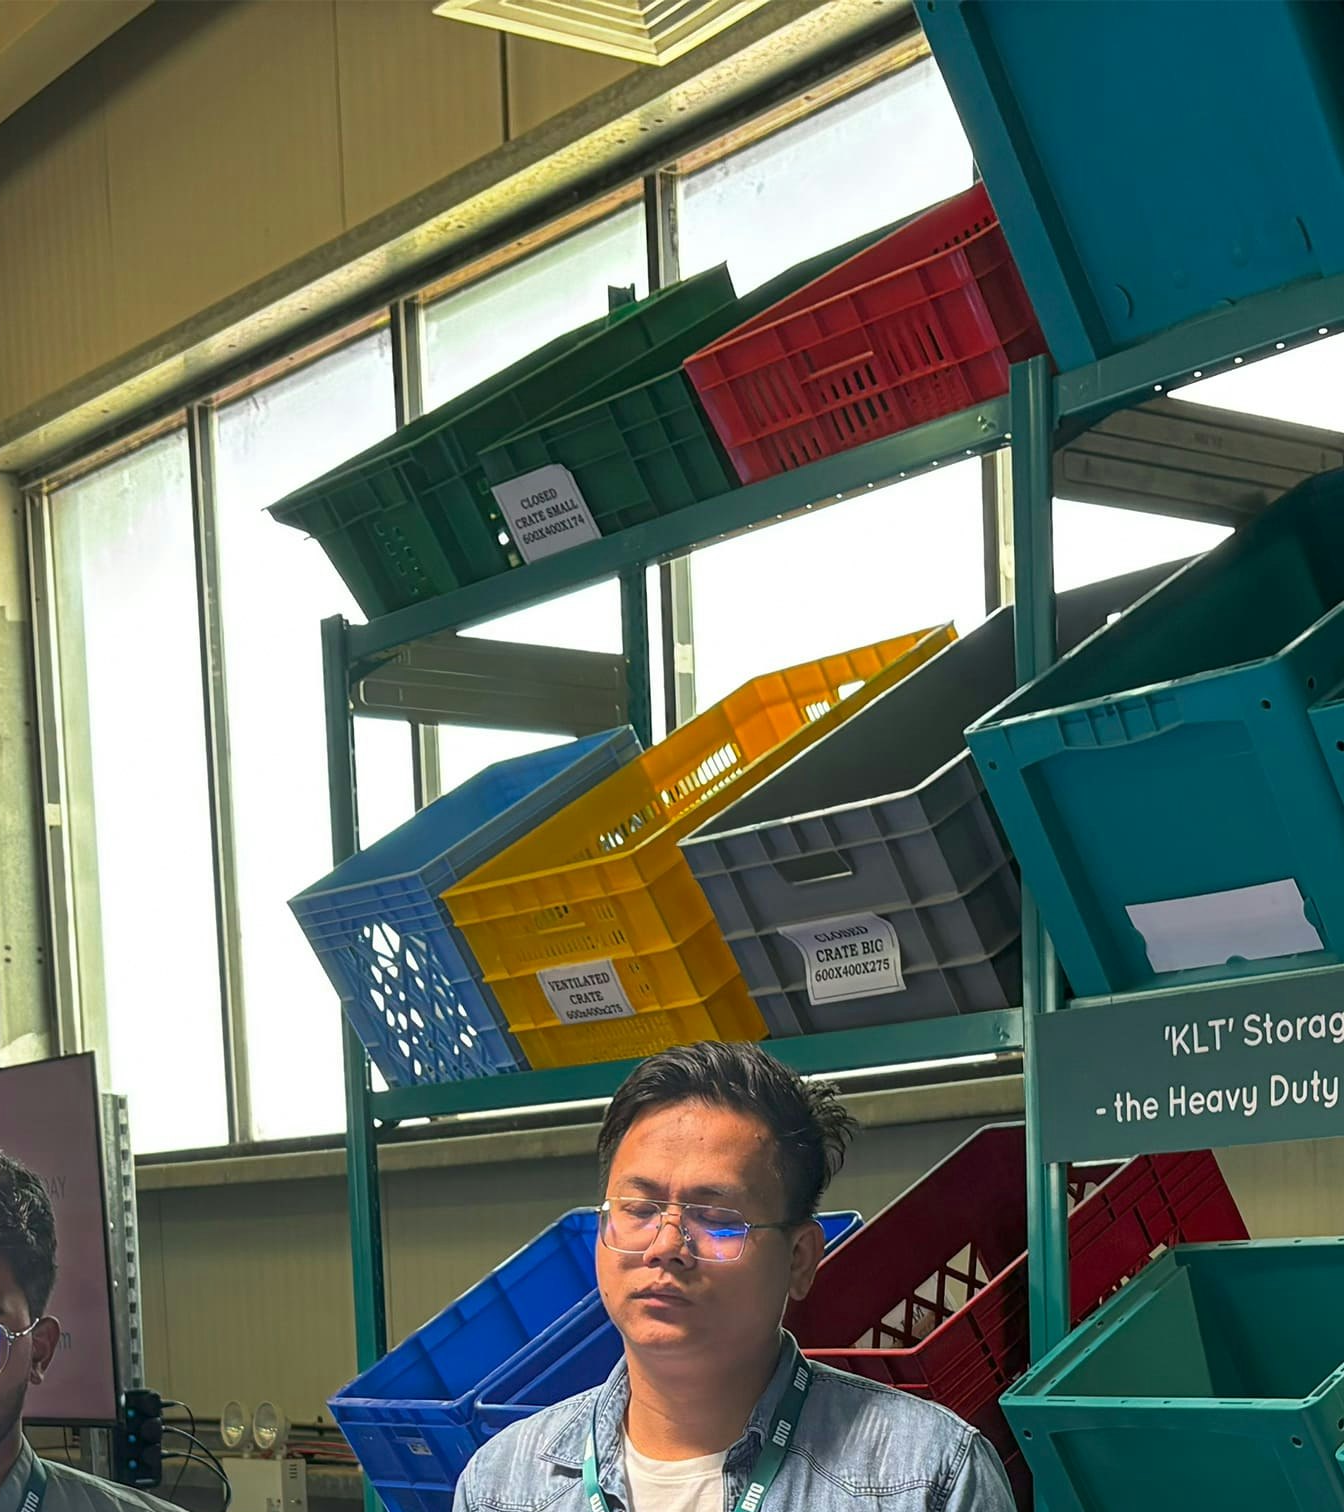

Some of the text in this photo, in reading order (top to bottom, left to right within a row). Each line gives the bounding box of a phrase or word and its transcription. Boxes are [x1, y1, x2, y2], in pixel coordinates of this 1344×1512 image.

[520, 488, 558, 510] CLOSED
[515, 499, 579, 529] CRATE SMALL
[814, 925, 869, 943] CLOSED
[816, 938, 884, 963] CRATE BIG
[815, 958, 890, 982] 600X400X275
[548, 972, 610, 992] VENTILATED
[569, 990, 604, 1005] CRATE
[1114, 1092, 1158, 1123] the
[1169, 1083, 1258, 1117] Heavy
[1270, 1069, 1339, 1108] Duty
